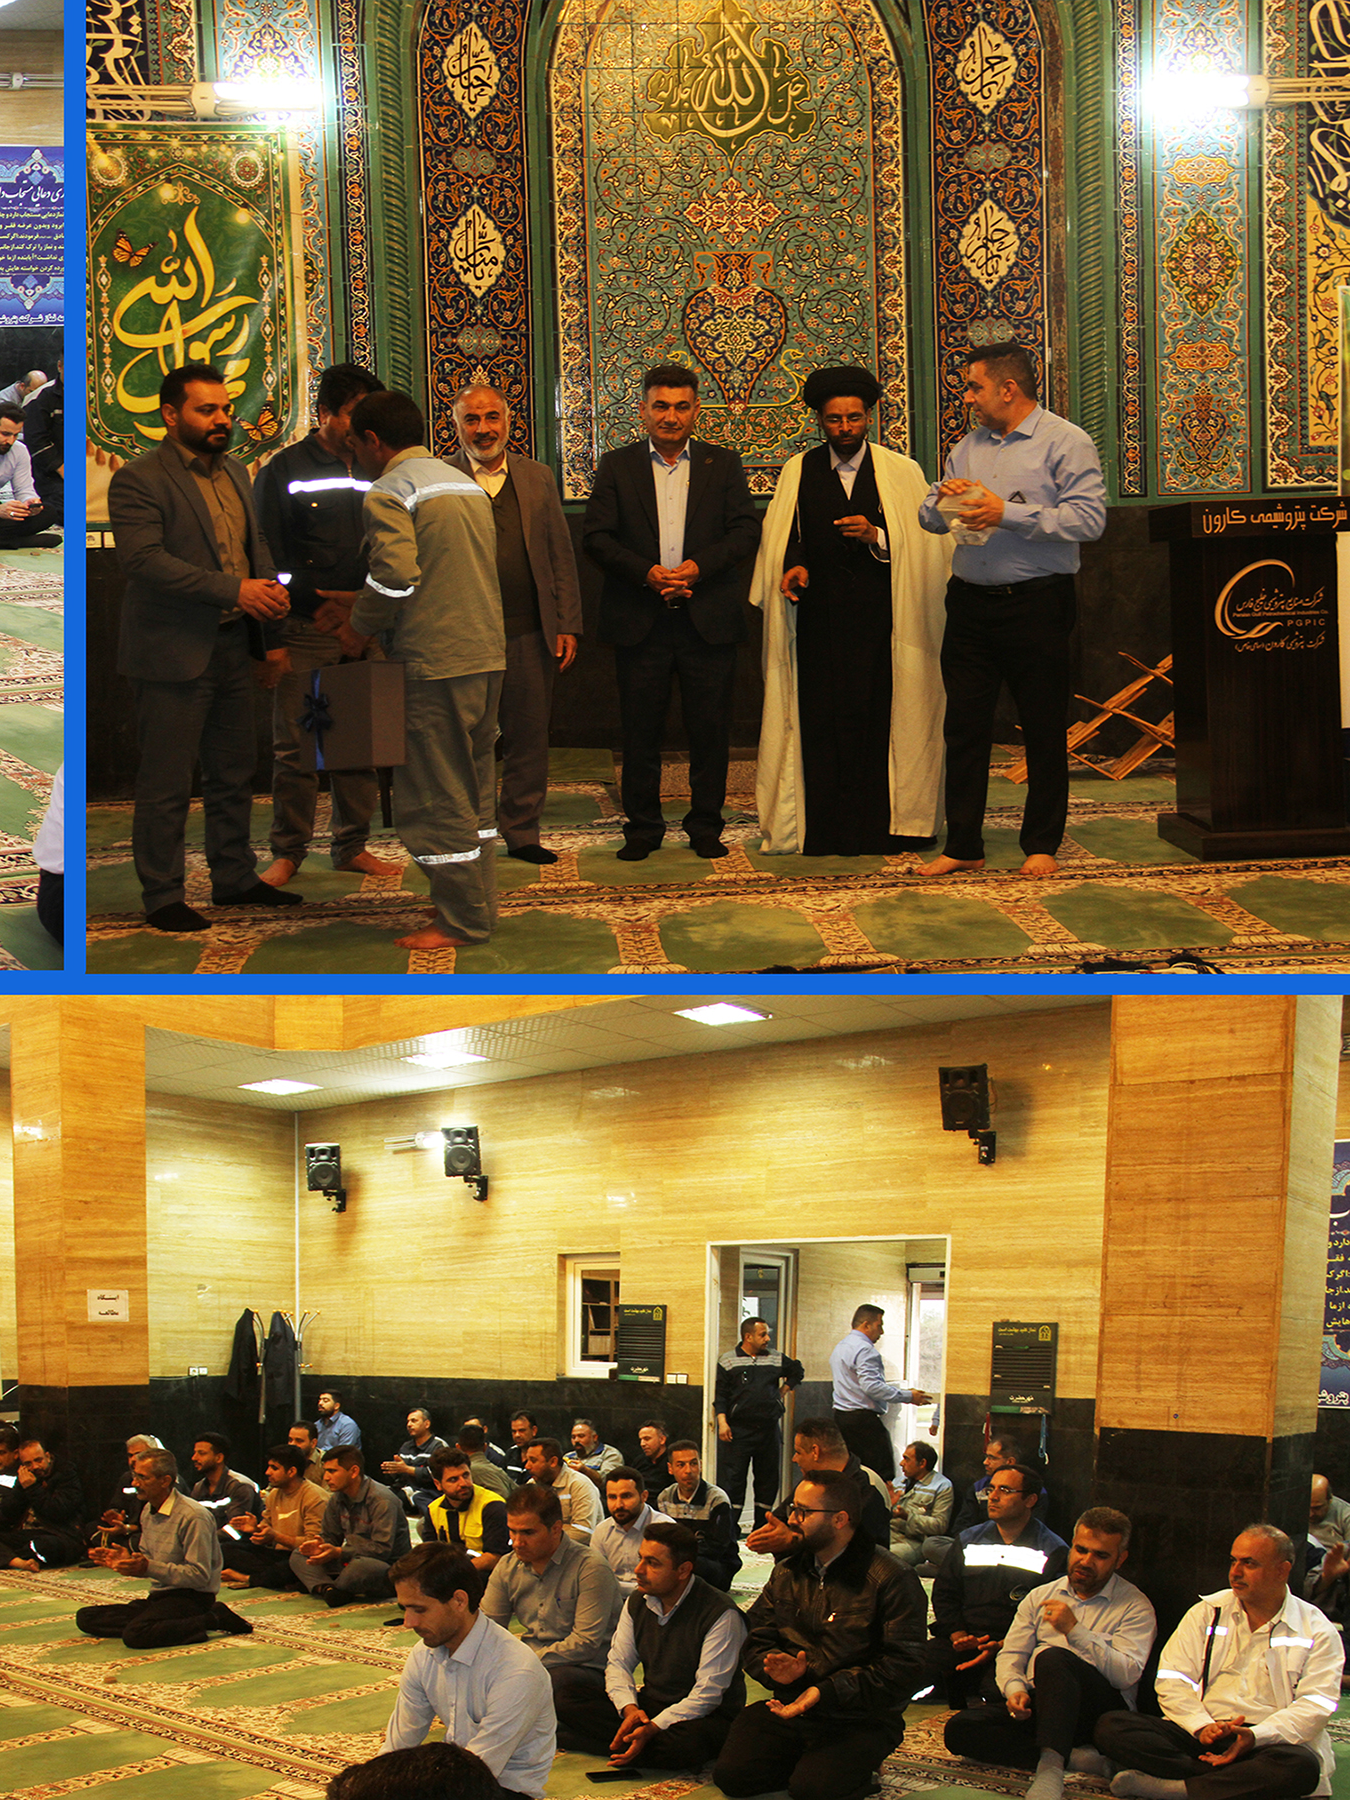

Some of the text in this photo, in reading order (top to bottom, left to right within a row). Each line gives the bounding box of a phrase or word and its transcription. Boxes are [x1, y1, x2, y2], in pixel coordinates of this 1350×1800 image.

[1202, 501, 1348, 534] شرکت پتروشیمی کارون
[1287, 618, 1326, 627] PGPIC
